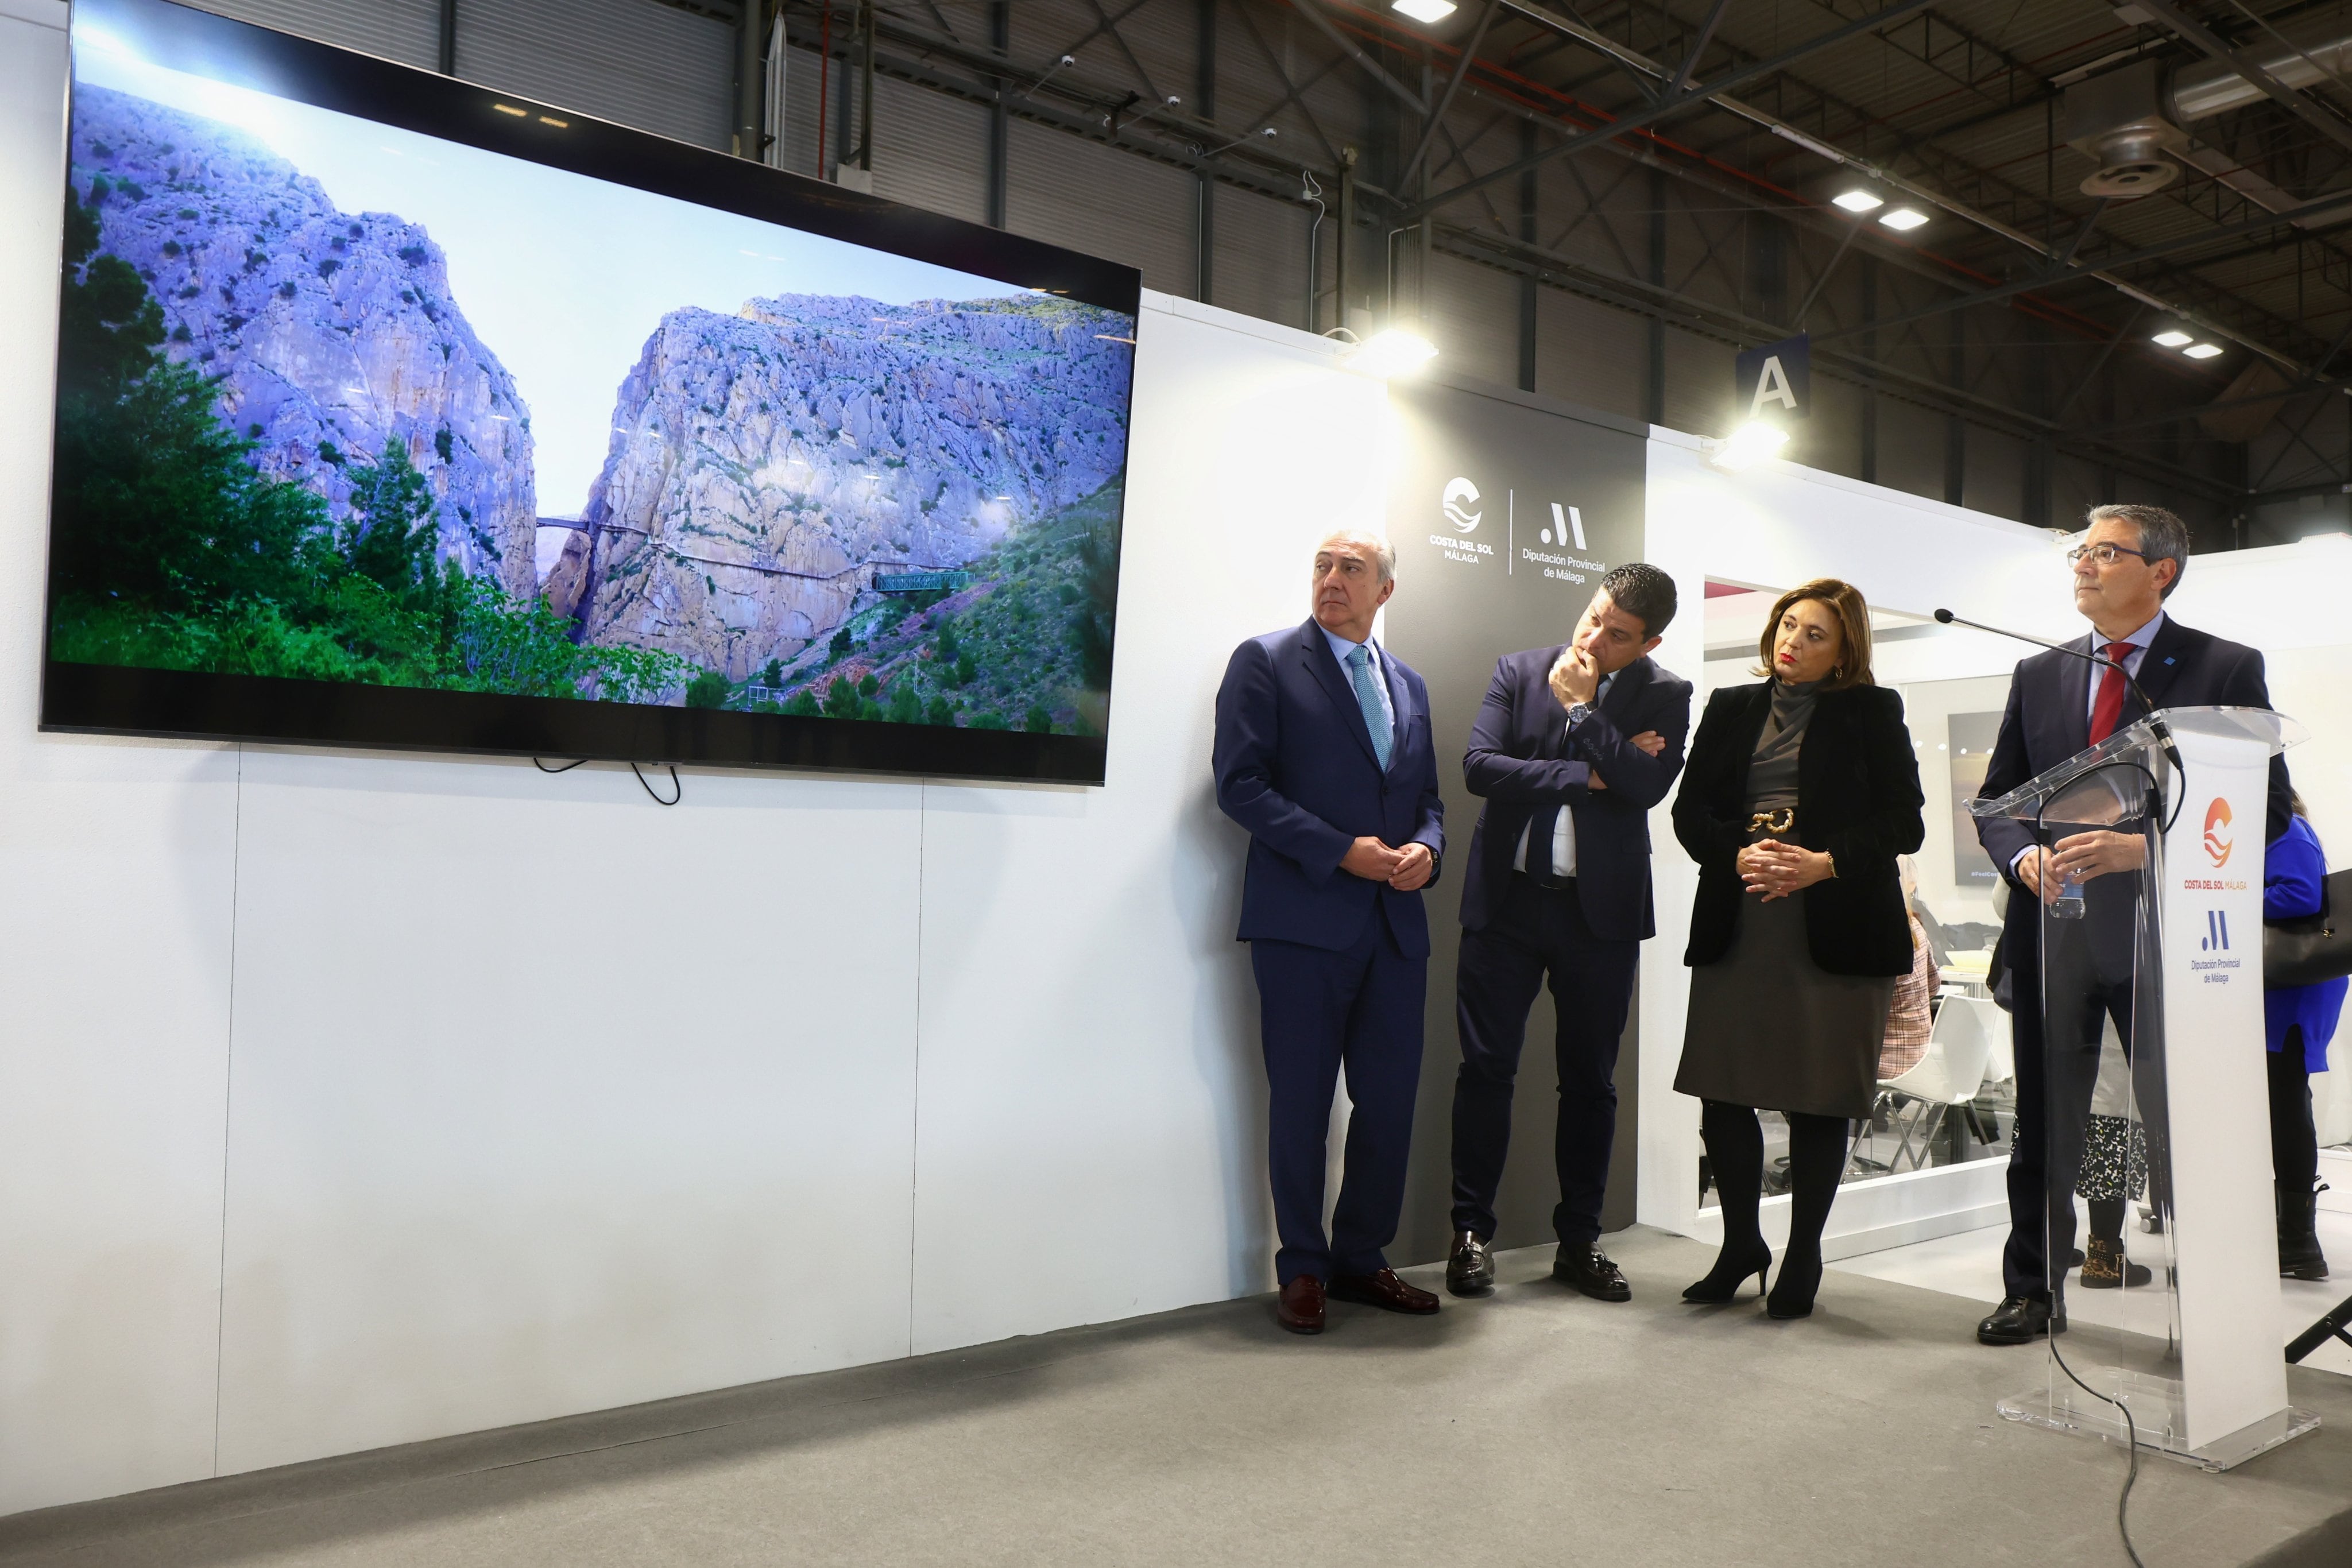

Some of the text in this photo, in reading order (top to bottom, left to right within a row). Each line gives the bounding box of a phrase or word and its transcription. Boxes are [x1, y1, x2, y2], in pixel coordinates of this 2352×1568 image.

[1748, 355, 1797, 420] A
[1429, 534, 1494, 555] COSTA DEL SOL
[1444, 549, 1479, 564] MÁLAGA
[1522, 548, 1606, 572] Diputación Provincial
[1544, 567, 1585, 584] de Málaga
[2184, 878, 2247, 890] COSTA DEL SOL MÁLAGA
[2191, 958, 2241, 971] Diputación Provincial
[2204, 973, 2229, 985] de Málaga
